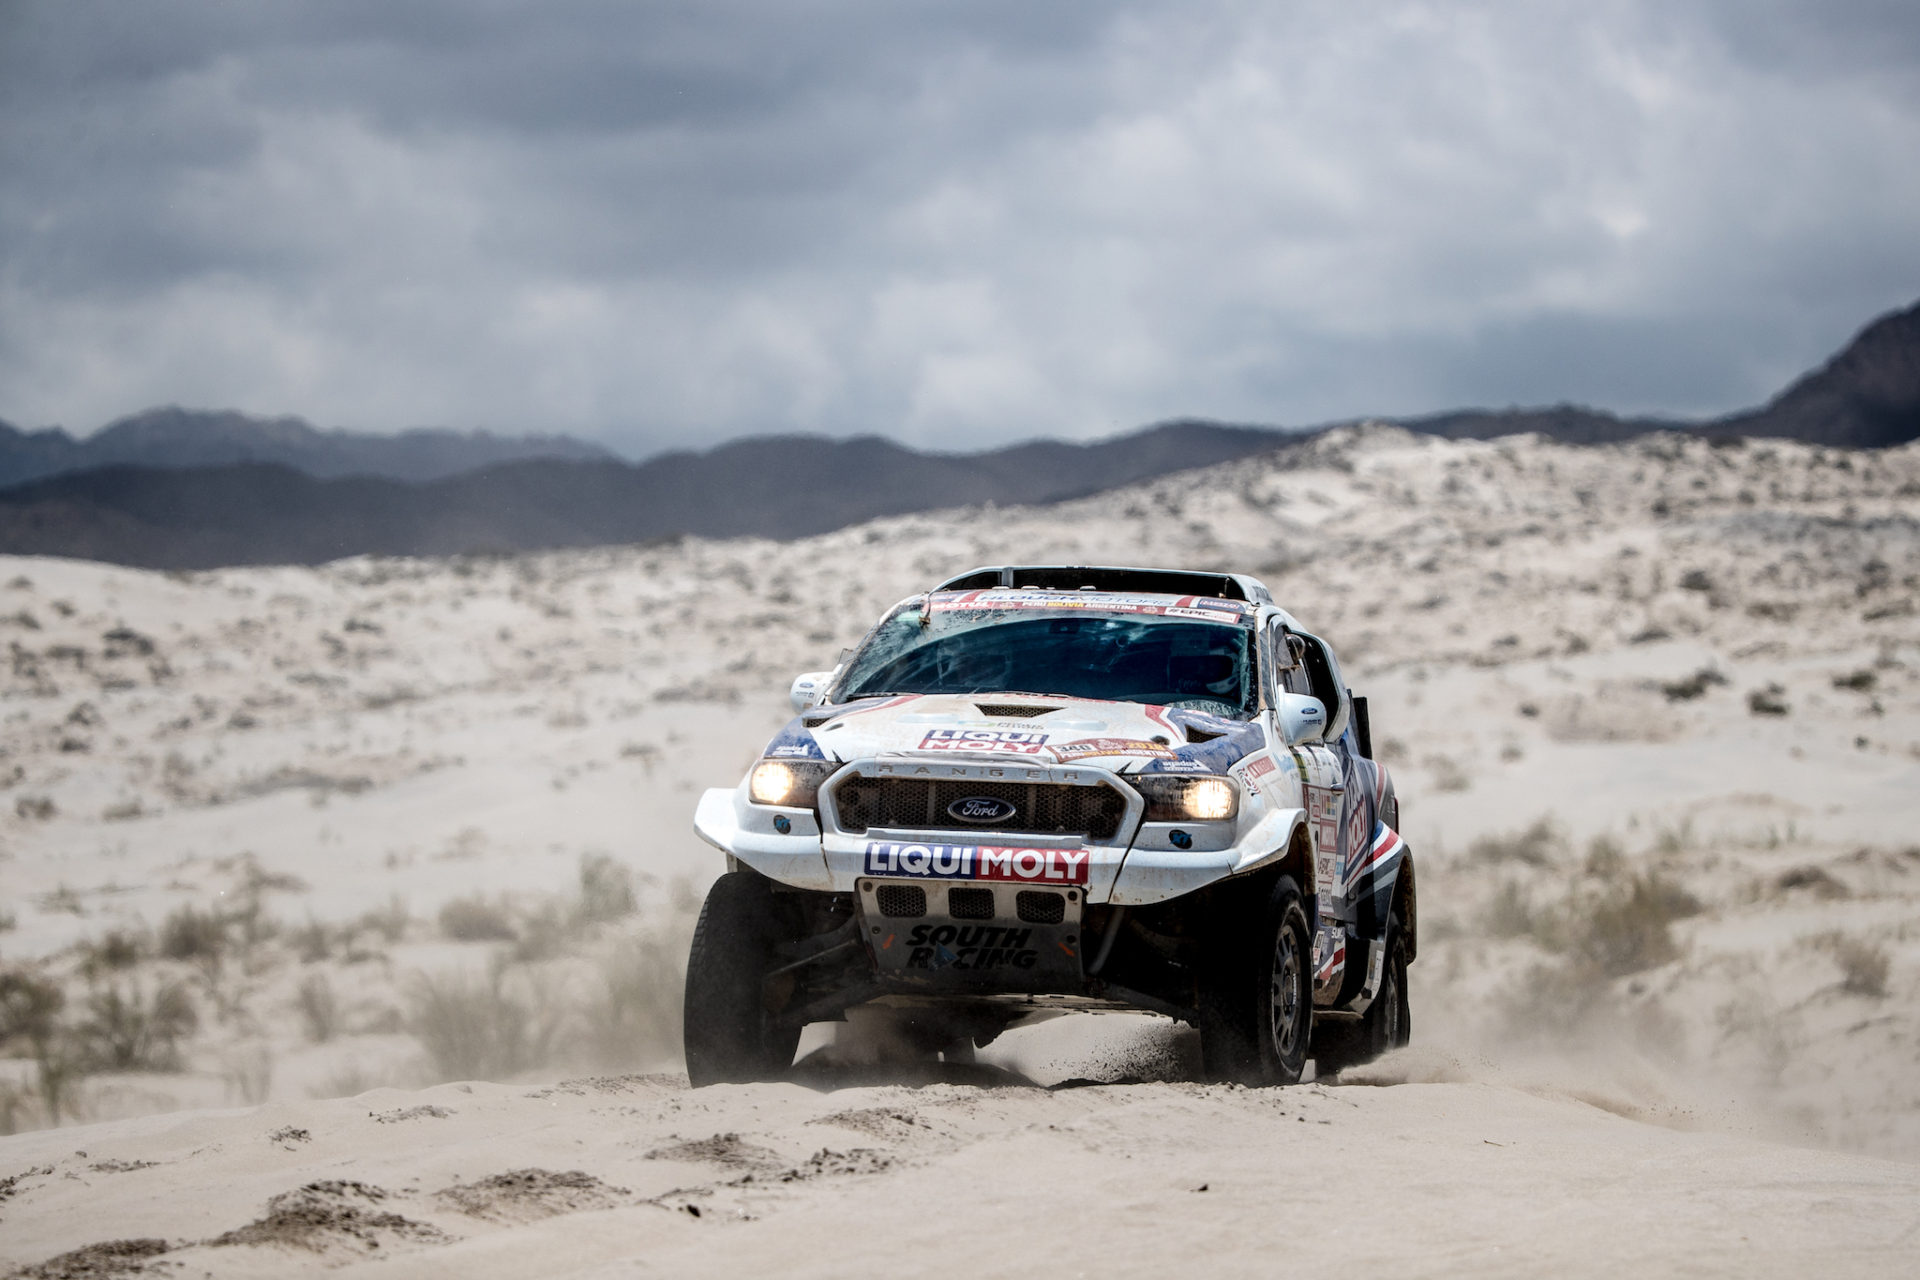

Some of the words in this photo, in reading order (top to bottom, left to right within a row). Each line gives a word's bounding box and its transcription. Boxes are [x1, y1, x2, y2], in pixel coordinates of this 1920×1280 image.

[930, 730, 1045, 744] LIQUI
[923, 740, 1037, 754] MOLY
[1126, 742, 1165, 751] 2018
[879, 765, 1079, 780] RANGER
[962, 799, 1000, 818] Ford
[869, 843, 973, 876] LIQUI
[980, 849, 1088, 880] MOLY
[906, 924, 1033, 949] SOUTH
